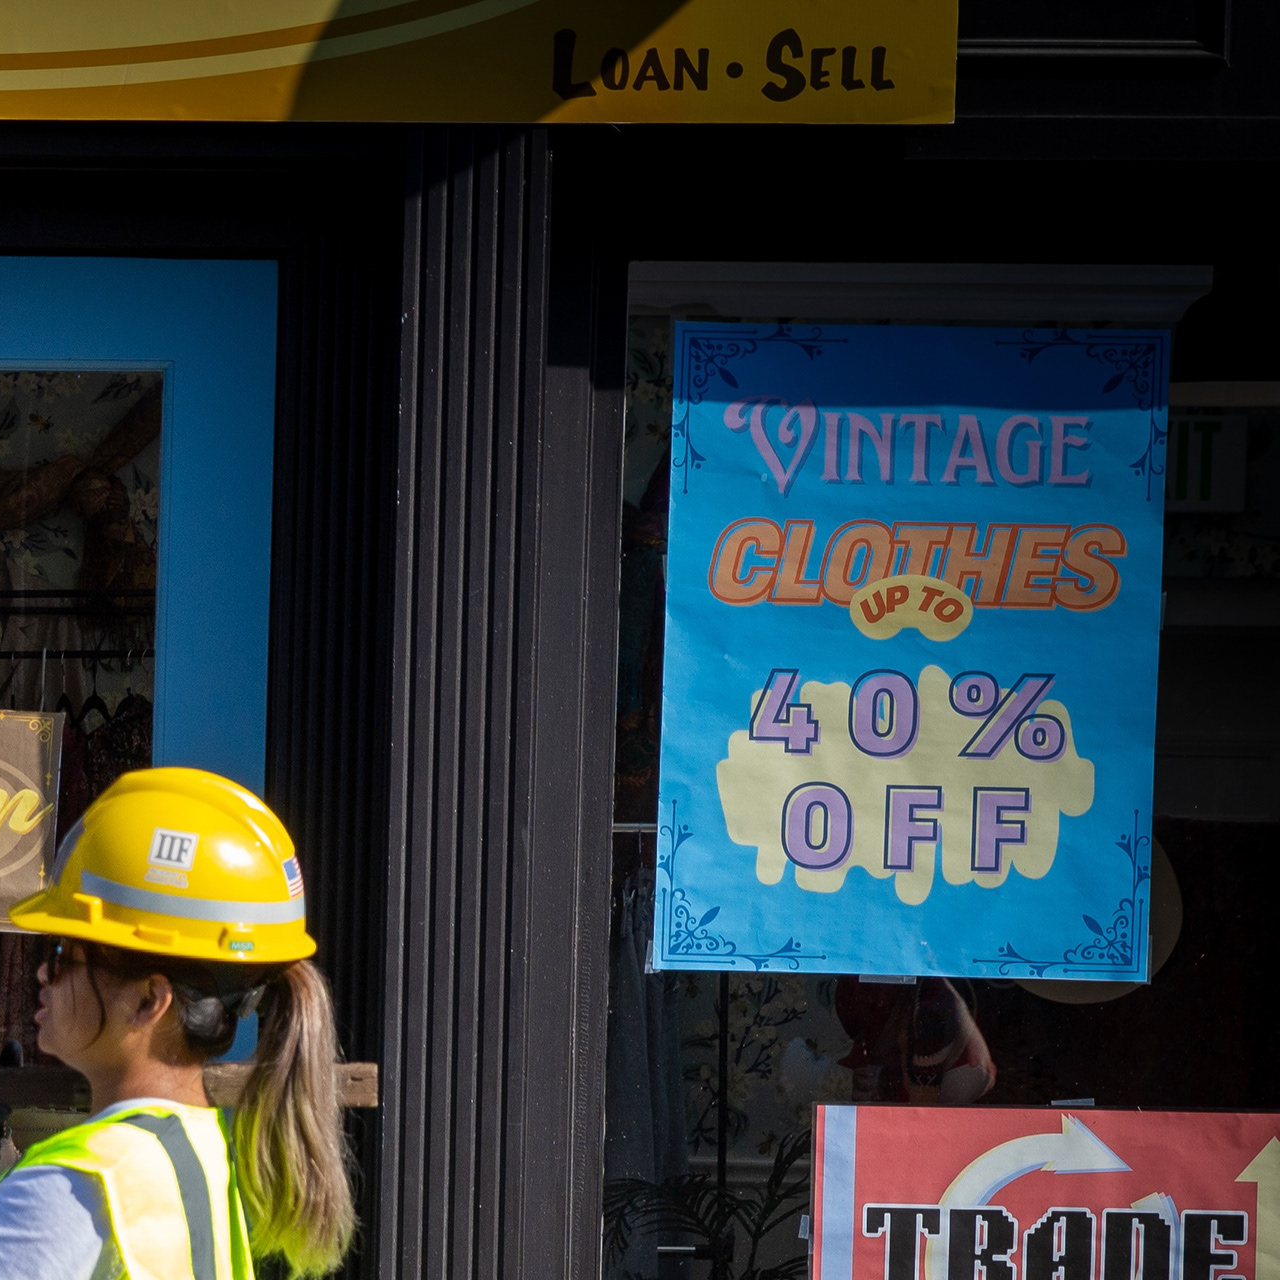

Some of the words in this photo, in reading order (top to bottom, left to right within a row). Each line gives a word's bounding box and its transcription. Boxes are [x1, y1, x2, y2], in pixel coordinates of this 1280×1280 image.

[723, 395, 1094, 498] VINTAGE
[708, 517, 1128, 613] CLOTHES
[859, 583, 910, 625] UP
[920, 584, 965, 625] TO
[780, 781, 1032, 874] OFF
